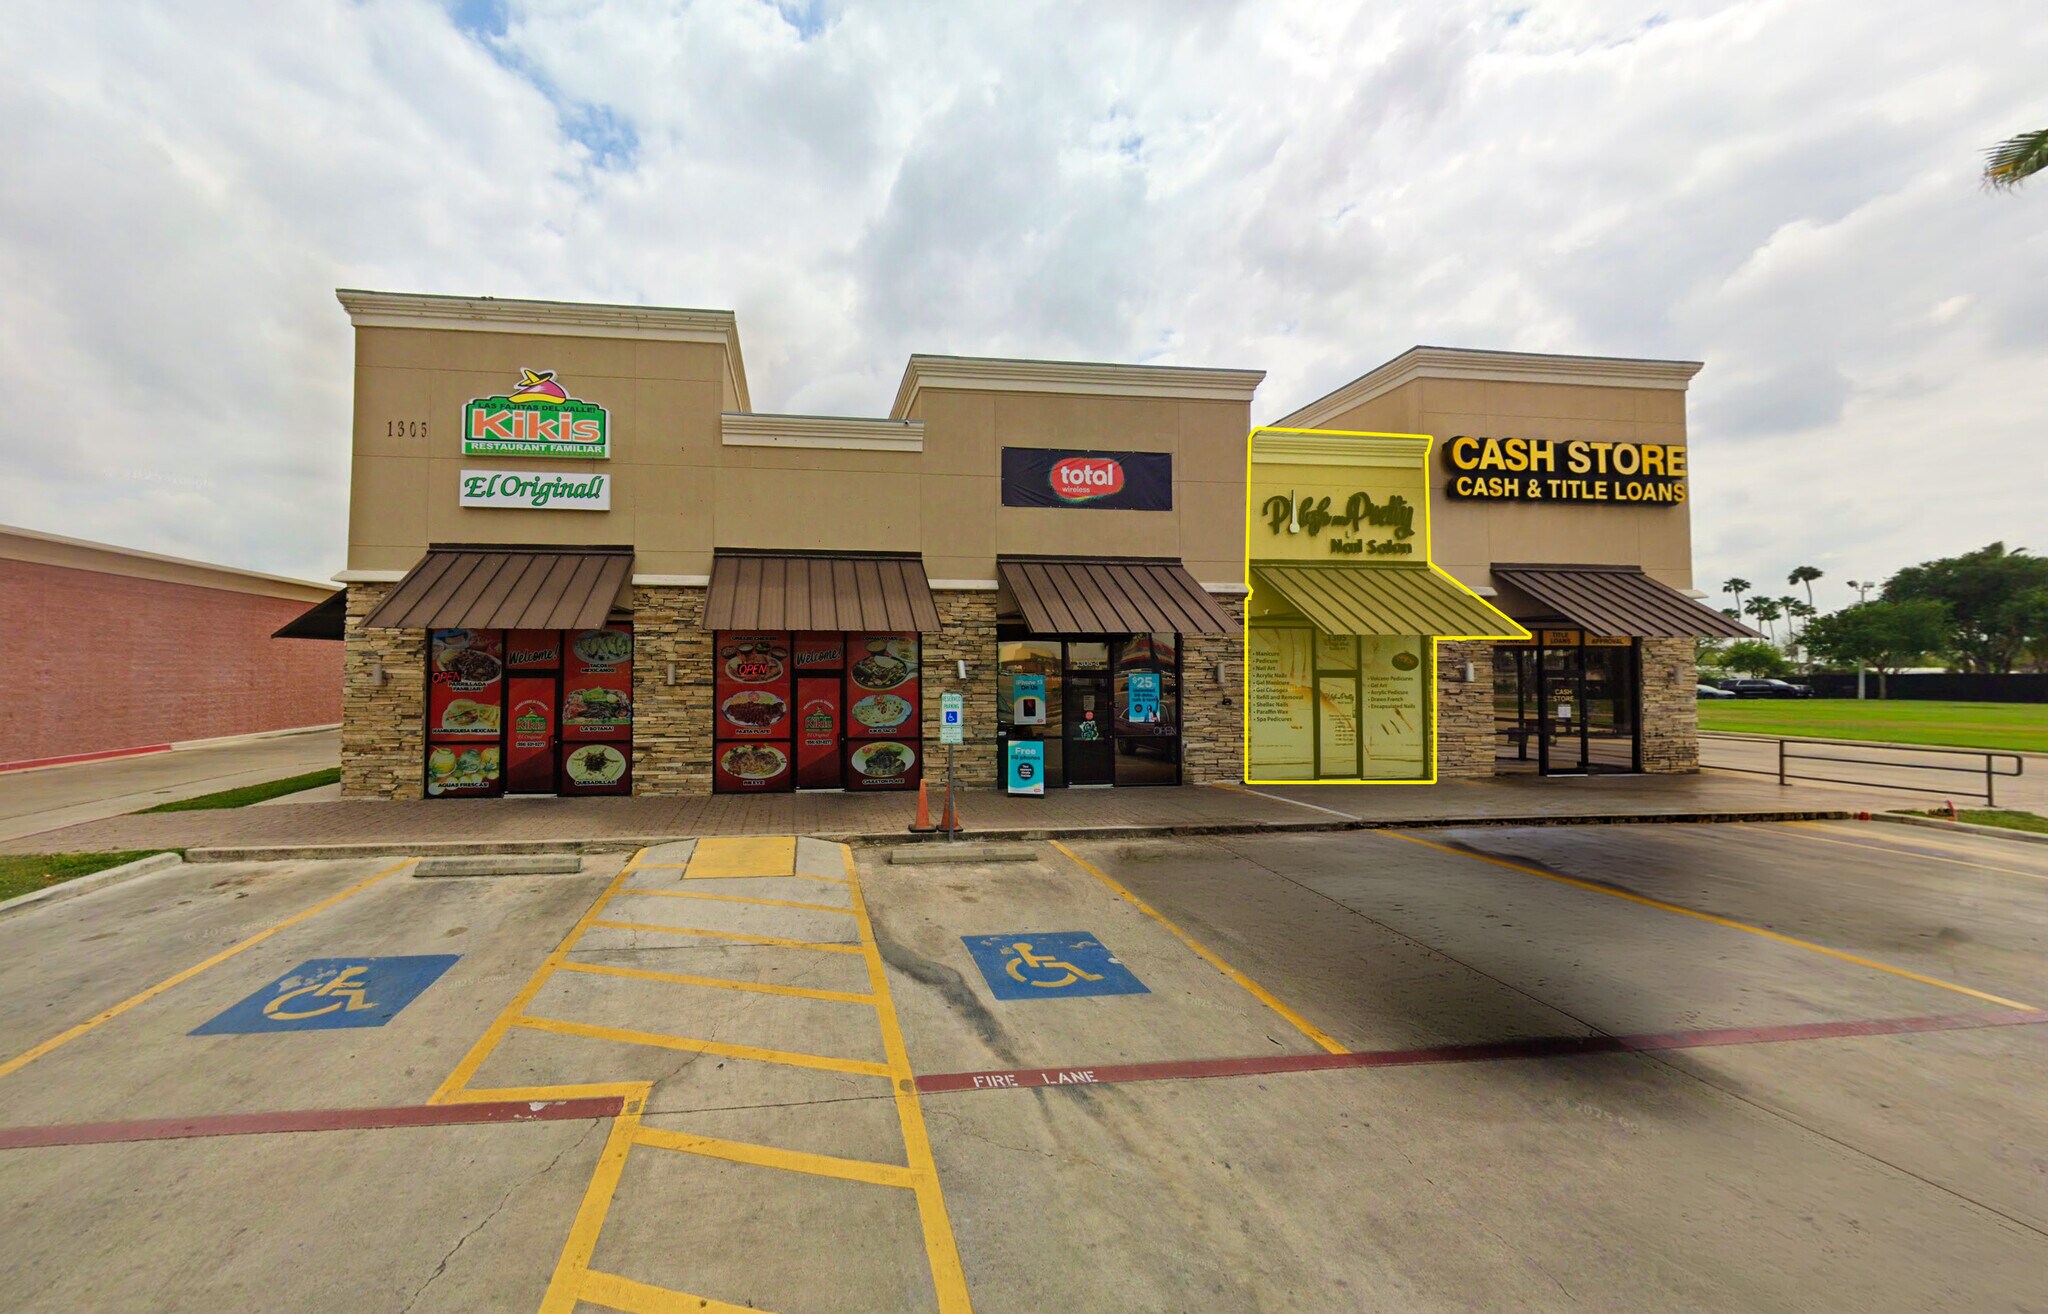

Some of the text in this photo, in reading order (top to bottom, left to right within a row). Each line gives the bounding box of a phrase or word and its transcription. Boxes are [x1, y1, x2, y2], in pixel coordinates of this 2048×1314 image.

[500, 403, 538, 411] FAJITAS
[387, 420, 428, 438] 1305
[472, 408, 601, 443] Kikis
[471, 442, 602, 453] RESTAURANT FAMILIAR
[1452, 436, 1687, 477] CASH STORE
[1060, 463, 1114, 486] total
[464, 474, 604, 507] El Original!
[1456, 476, 1687, 501] CASH & TITLE LOANS
[1330, 538, 1413, 554] Nail Salon
[508, 643, 560, 665] Welcome!
[796, 643, 843, 666] Welcome!
[431, 671, 461, 684] OPEN
[739, 664, 768, 675] OPEN
[516, 719, 545, 731] Kikis
[805, 718, 833, 729] Kikis
[1153, 726, 1177, 736] OPEN
[1015, 747, 1036, 755] Free
[972, 1070, 1099, 1088] FIRE LANE
